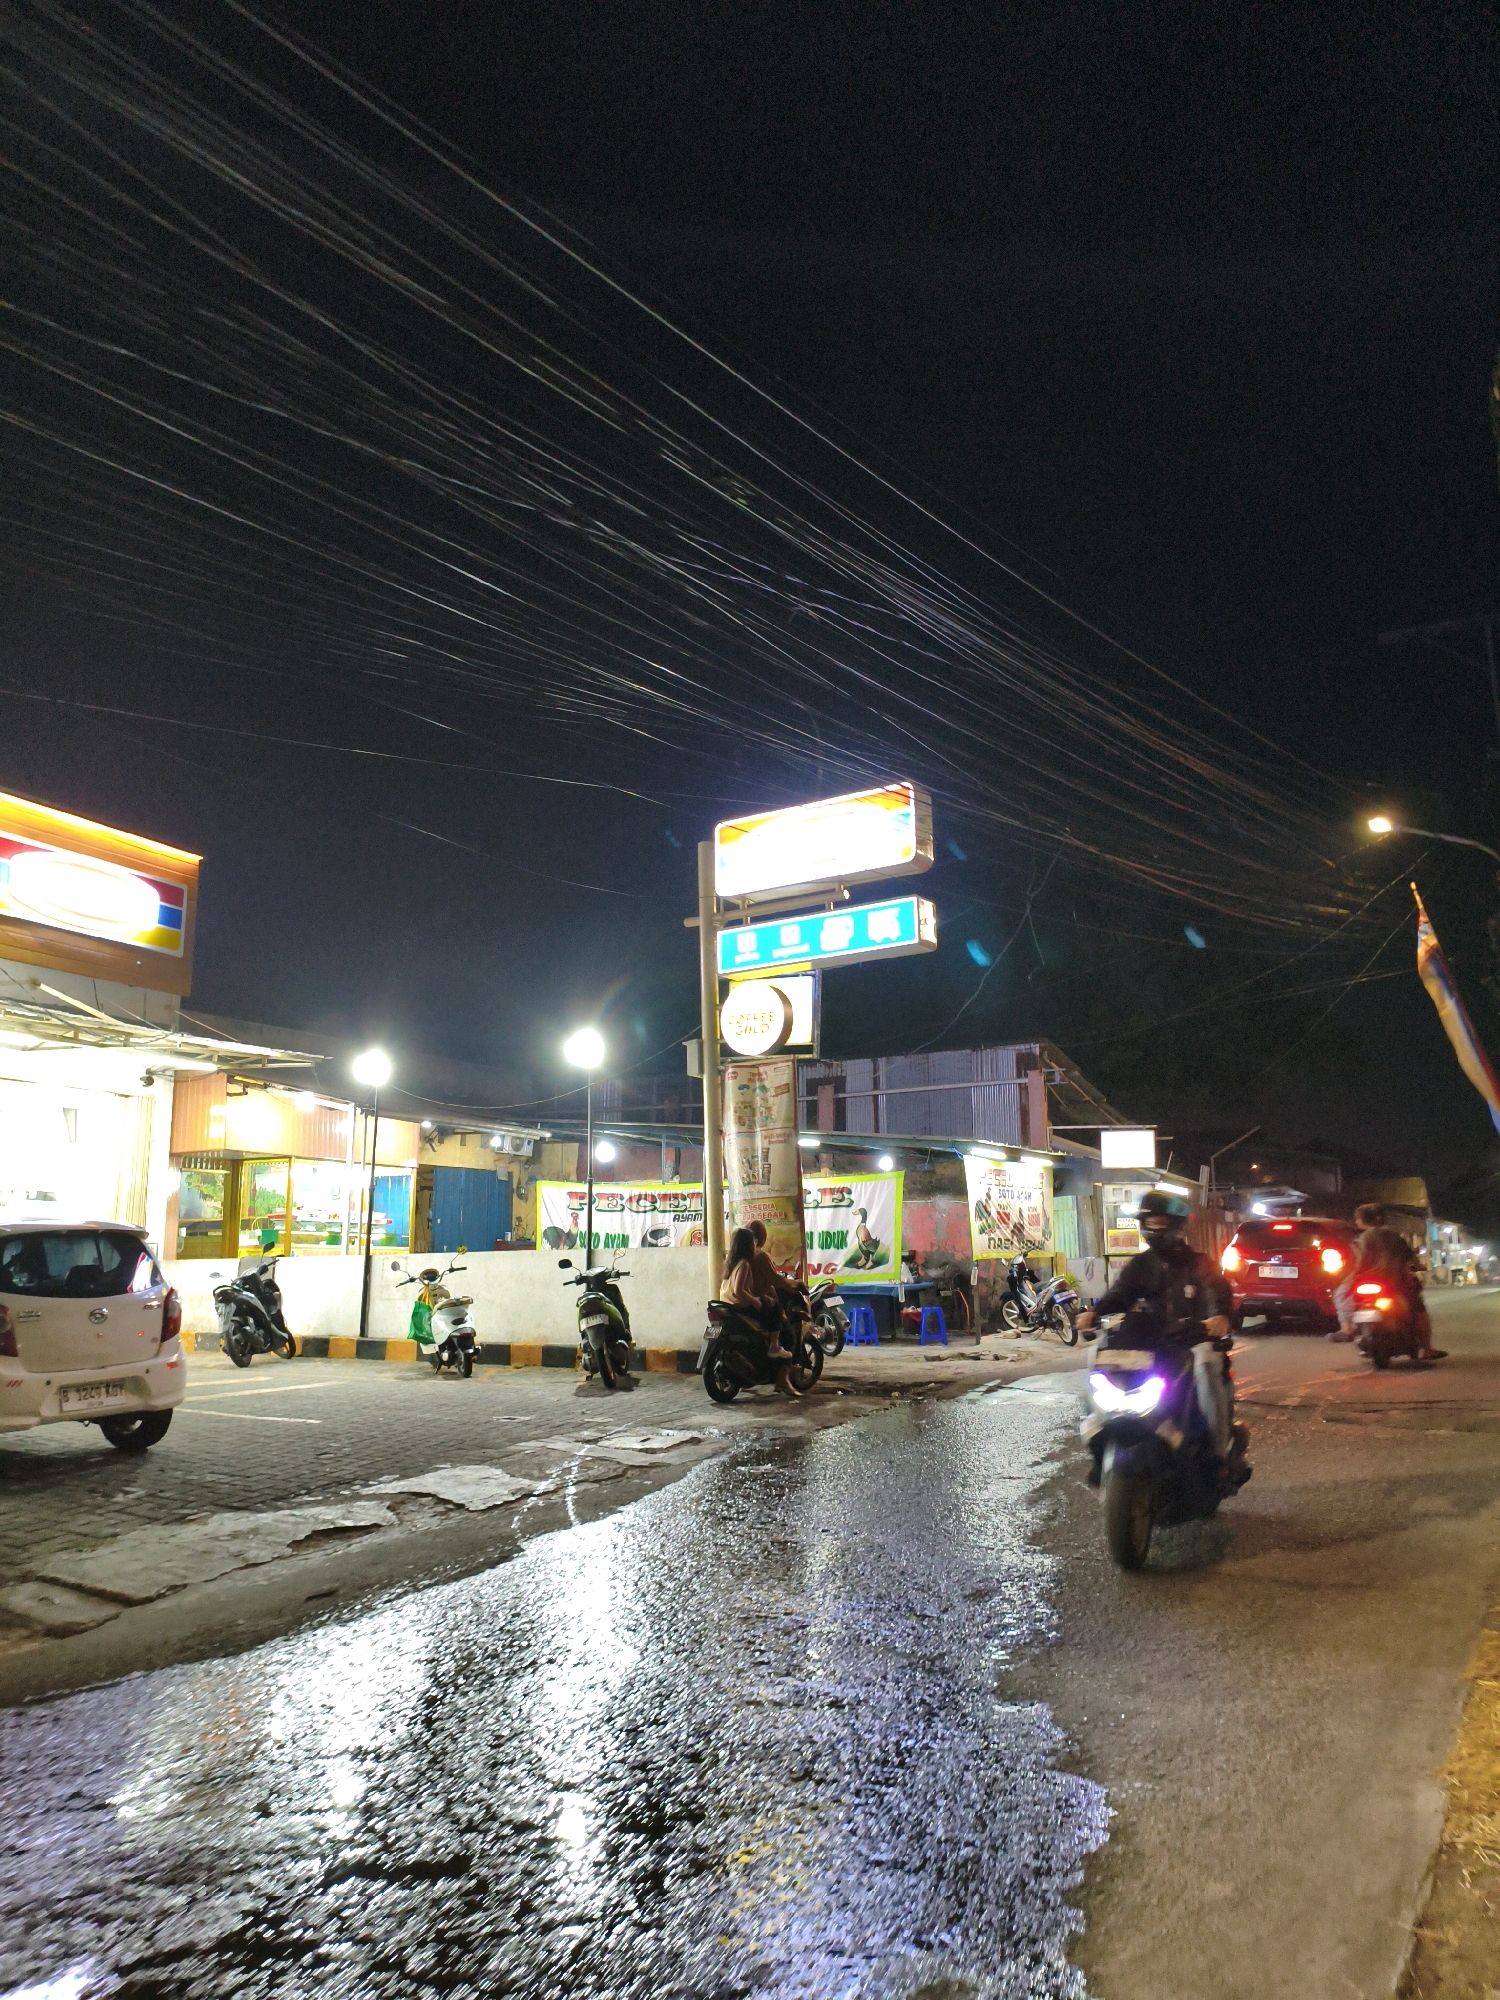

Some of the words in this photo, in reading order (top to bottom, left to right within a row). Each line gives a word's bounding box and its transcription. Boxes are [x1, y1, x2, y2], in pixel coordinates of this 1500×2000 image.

[728, 1011, 775, 1025] COFFEE
[672, 1212, 703, 1223] AYAM
[603, 1231, 630, 1249] AYAM
[818, 1229, 849, 1251] UDUK
[62, 1389, 71, 1404] B
